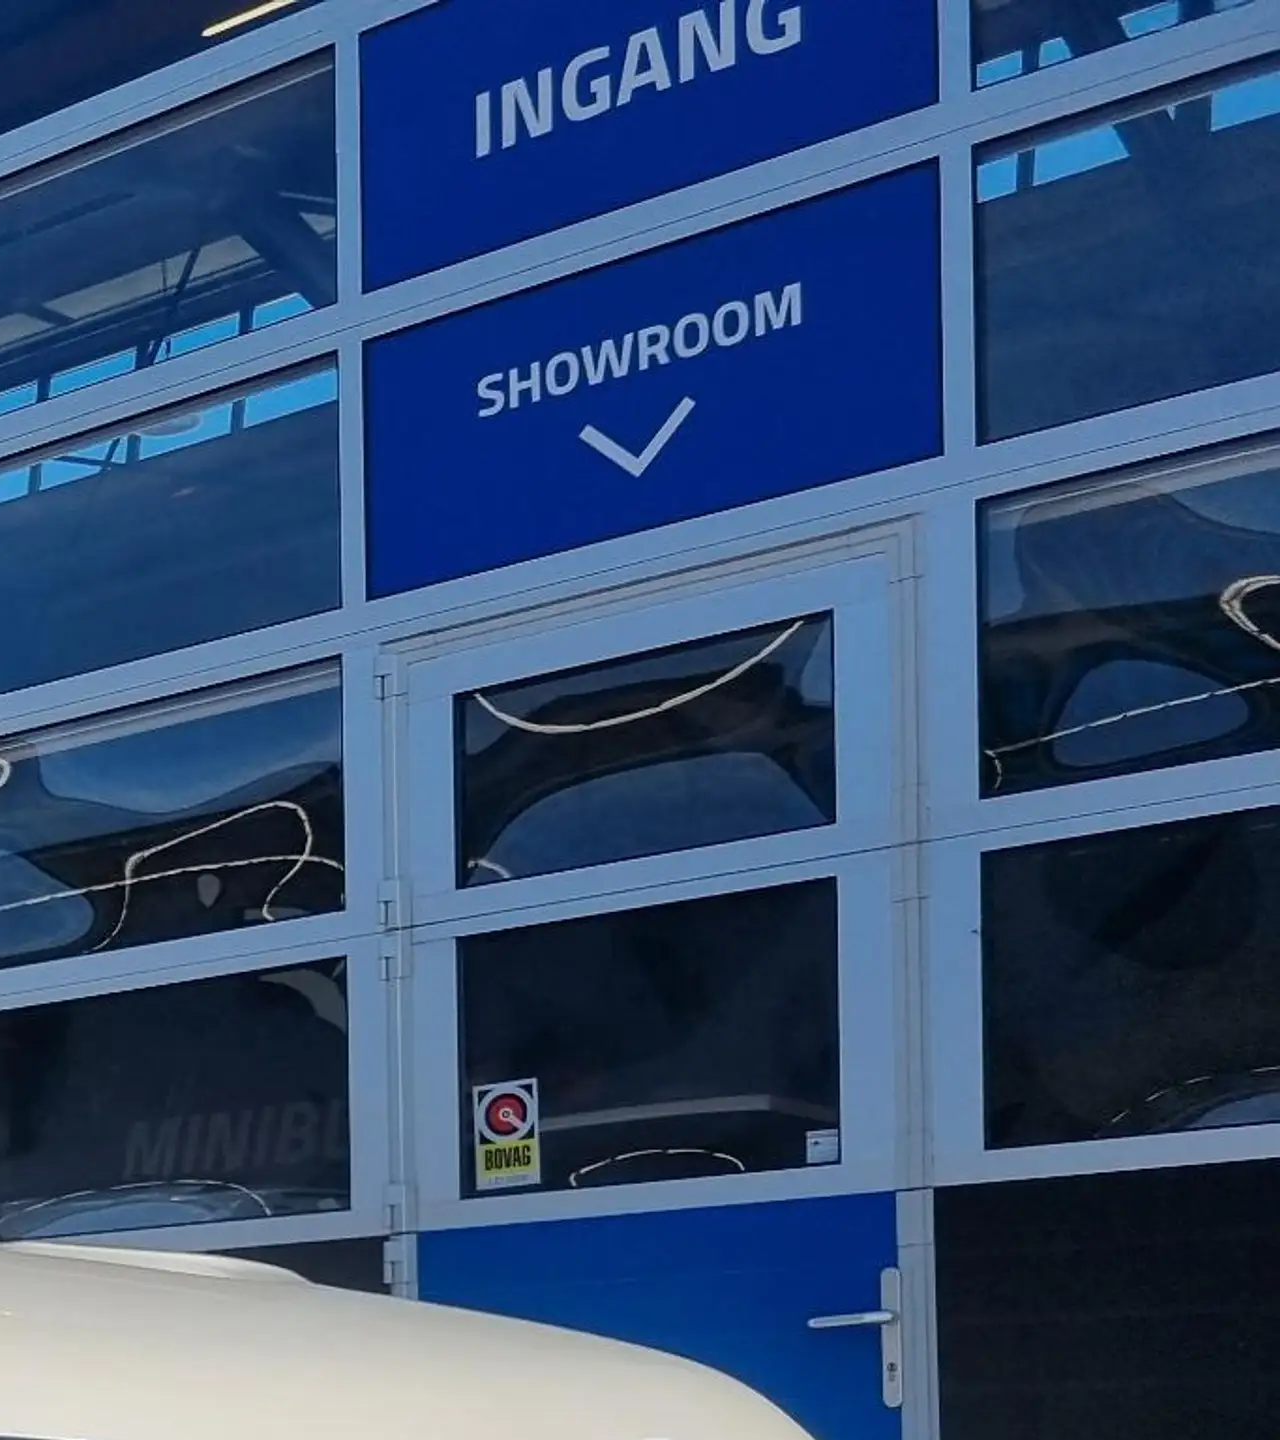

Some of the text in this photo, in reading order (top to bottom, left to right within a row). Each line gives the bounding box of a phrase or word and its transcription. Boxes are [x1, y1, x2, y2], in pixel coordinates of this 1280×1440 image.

[474, 0, 802, 158] INGANG
[477, 281, 802, 417] SHOWROOM
[484, 1145, 531, 1171] BOVAG
